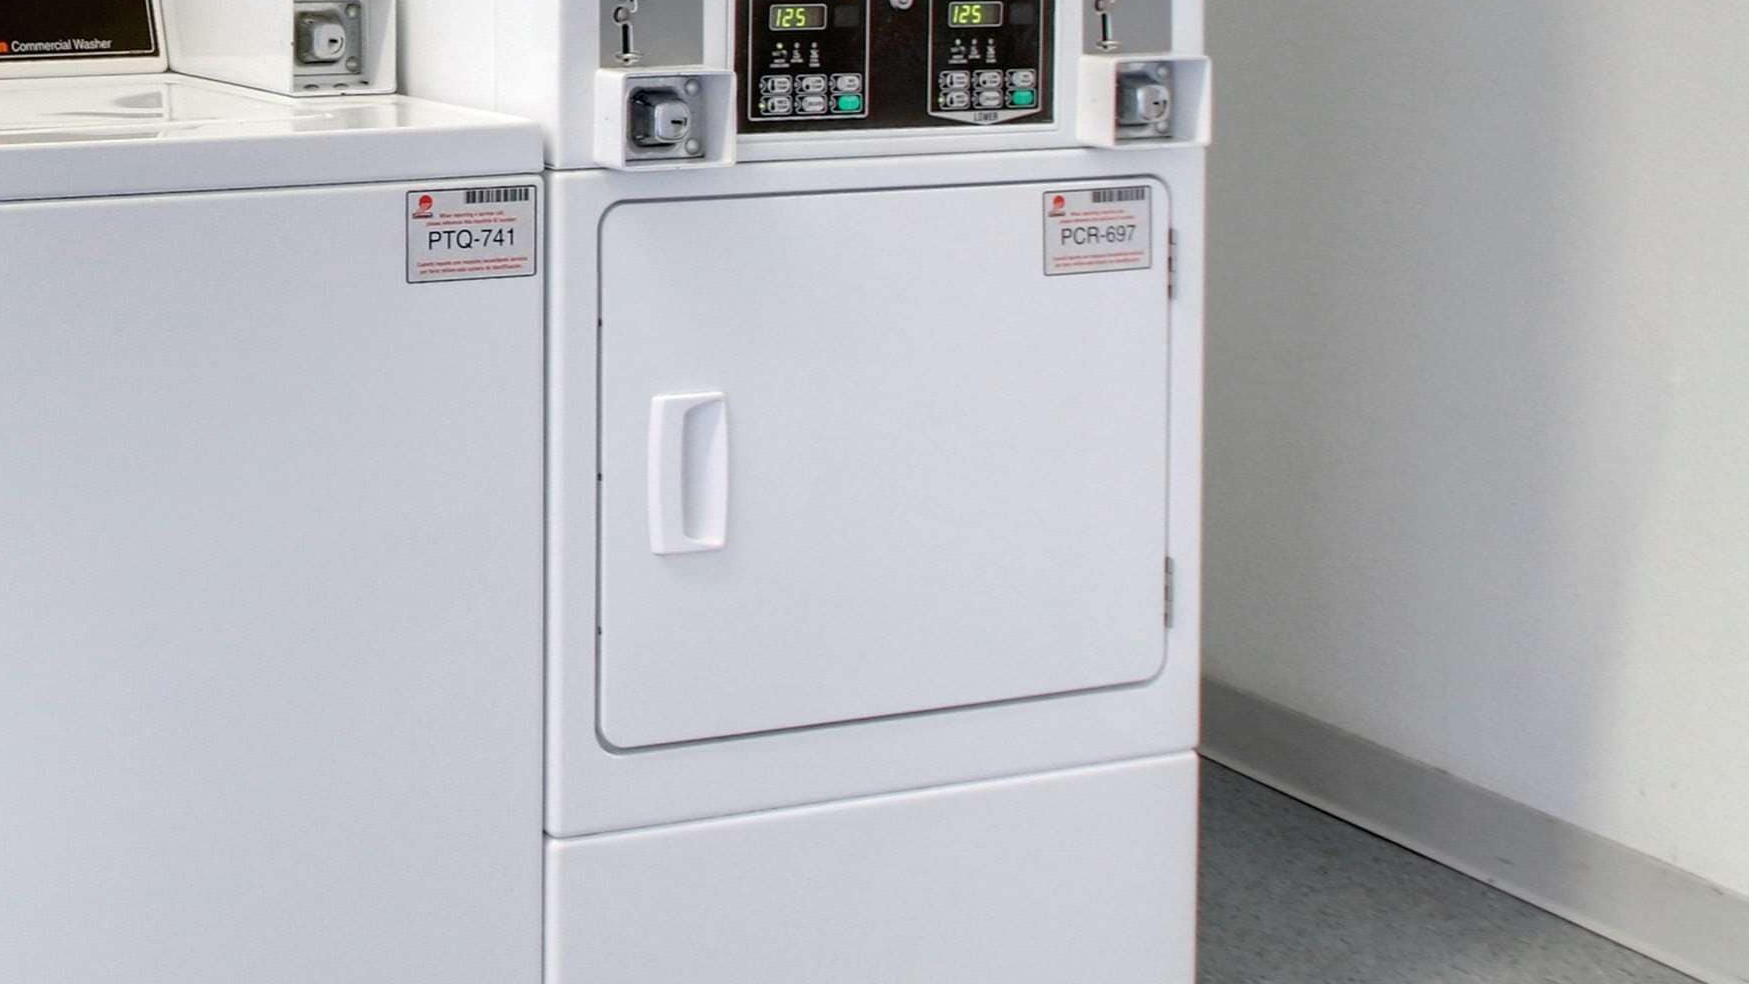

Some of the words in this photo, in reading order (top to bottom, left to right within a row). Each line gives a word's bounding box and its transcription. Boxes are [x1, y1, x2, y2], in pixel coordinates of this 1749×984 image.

[776, 8, 806, 27] 125
[953, 5, 982, 23] 125
[11, 40, 71, 53] Commercial
[73, 39, 112, 50] Washer
[974, 112, 998, 121] LOWER
[428, 228, 515, 250] PTQ-741
[1061, 224, 1136, 246] PCR-697
